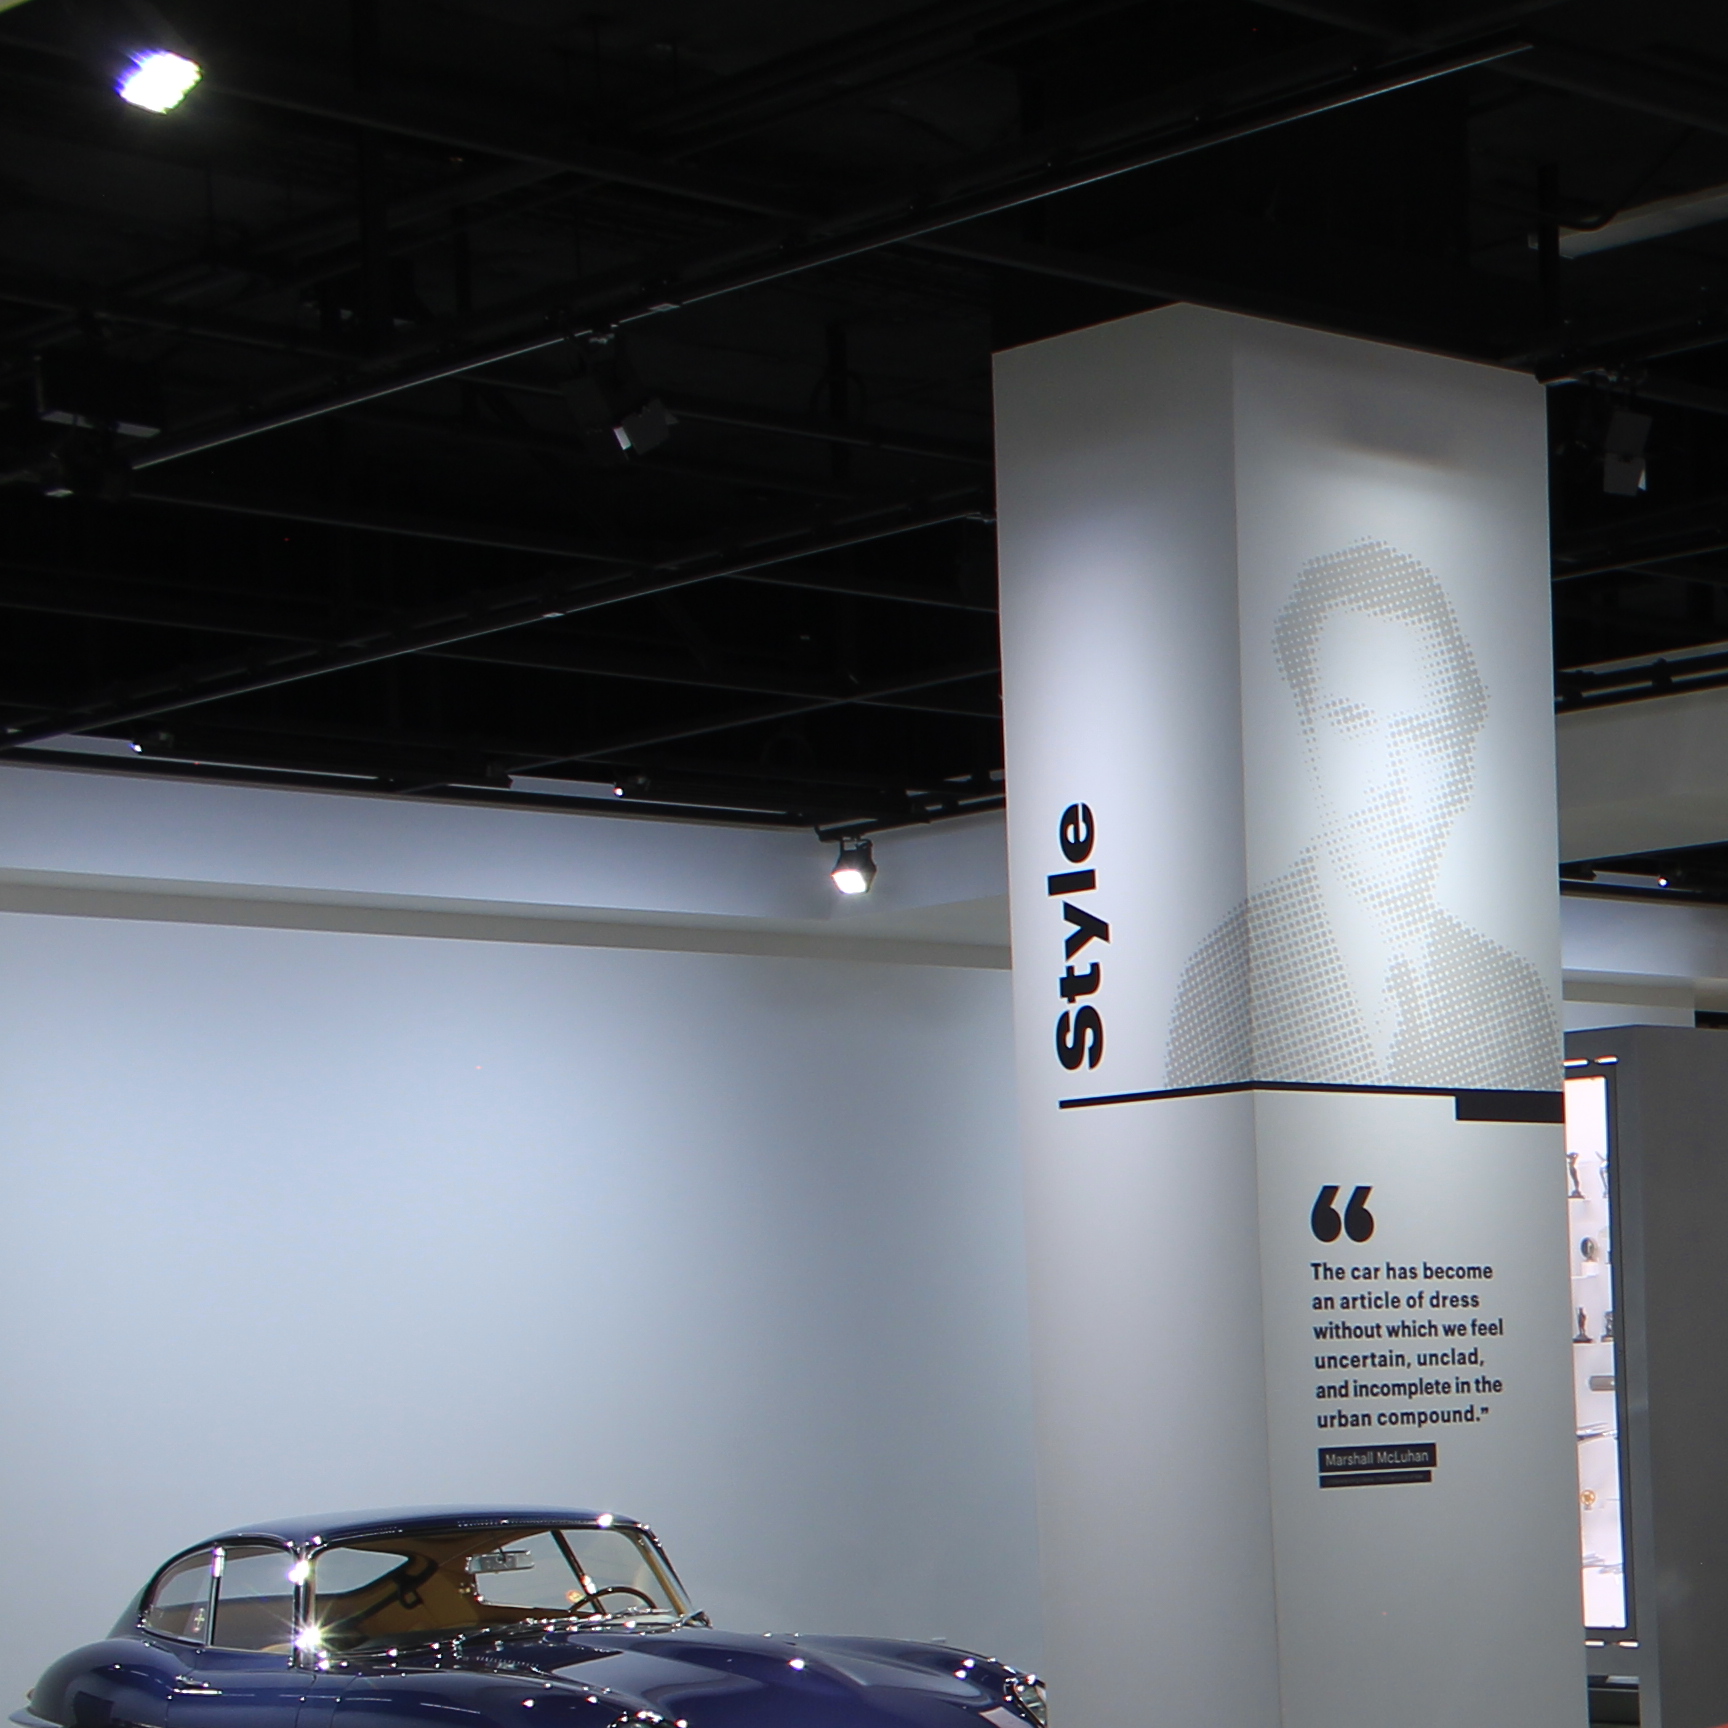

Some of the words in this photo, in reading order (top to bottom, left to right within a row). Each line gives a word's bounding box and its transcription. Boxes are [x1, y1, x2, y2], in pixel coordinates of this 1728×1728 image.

[1047, 803, 1110, 1070] Style
[1310, 1262, 1345, 1280] The
[1351, 1267, 1380, 1280] car
[1386, 1262, 1418, 1279] has
[1423, 1262, 1493, 1279] become
[1312, 1297, 1334, 1310] an
[1340, 1291, 1400, 1309] article
[1406, 1291, 1424, 1308] of
[1430, 1291, 1479, 1308] dress
[1313, 1321, 1382, 1339] without
[1386, 1319, 1438, 1338] which
[1442, 1324, 1467, 1336] we
[1471, 1318, 1503, 1336] feel
[1315, 1350, 1411, 1369] uncertain,
[1417, 1347, 1484, 1367] unclad,
[1316, 1380, 1349, 1399] and
[1353, 1378, 1451, 1399] incomplete
[1455, 1377, 1471, 1394] in
[1474, 1375, 1502, 1393] the
[1317, 1409, 1371, 1428] urban
[1325, 1452, 1374, 1467] Marshall
[1376, 1450, 1429, 1464] McLuhan
